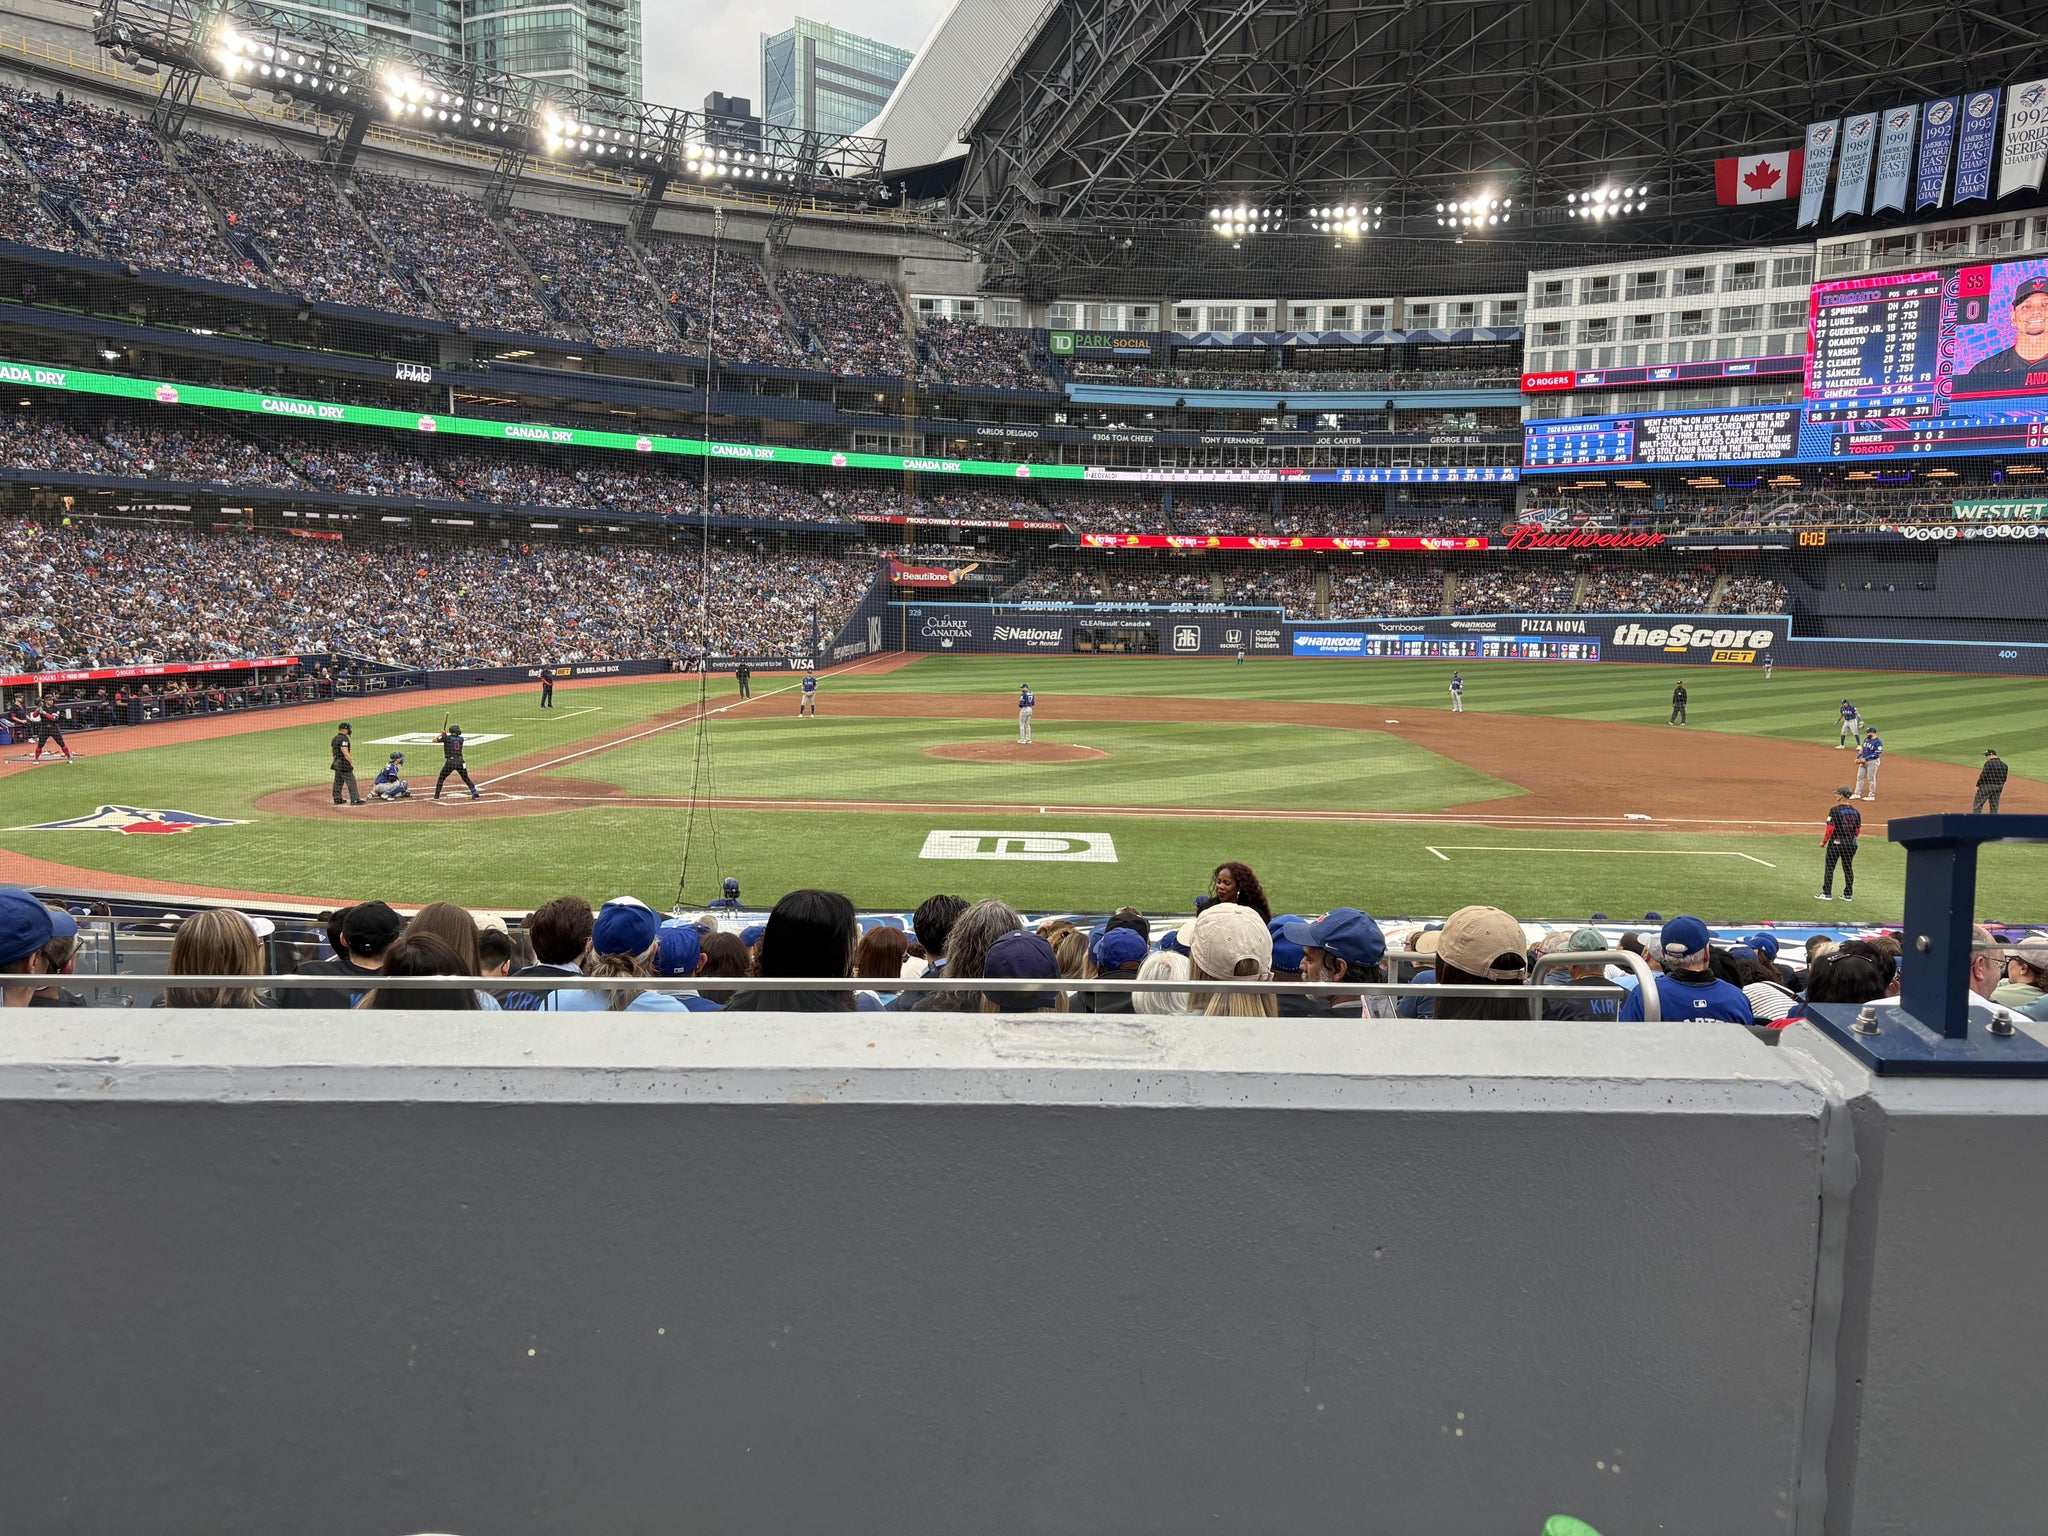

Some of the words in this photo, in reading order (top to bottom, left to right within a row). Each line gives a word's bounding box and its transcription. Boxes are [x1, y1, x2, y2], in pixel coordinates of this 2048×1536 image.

[2011, 107, 2048, 129] 1992
[1886, 133, 1908, 145] 1991
[1927, 126, 1951, 139] 1992
[2008, 127, 2048, 143] WORLD
[1847, 140, 1869, 152] 1989
[1963, 140, 1990, 151] LEAGUE
[2005, 139, 2047, 156] SERIES
[1810, 147, 1832, 159] 1985
[1882, 153, 1908, 163] LEAGUE
[1962, 148, 1988, 161] EAST
[2004, 151, 2046, 165] CHAMPIONS
[1842, 159, 1867, 170] LEAGUE
[1881, 161, 1907, 172] EAST
[1842, 168, 1866, 179] EAST
[1960, 172, 1985, 186] ALCS
[1967, 274, 1983, 288] SS
[1830, 305, 1868, 316] SPRINGER
[1901, 300, 1919, 309] .679
[1830, 317, 1854, 326] LUKES
[1900, 311, 1917, 319] .753
[1829, 326, 1868, 336] GUERRERO
[1870, 324, 1883, 333] JR.
[1900, 321, 1916, 330] .712
[1053, 336, 1072, 349] TD
[1076, 335, 1112, 346] PARK
[1113, 339, 1151, 348] SOCIAL
[1828, 337, 1865, 346] OKAMOTO
[1885, 334, 1895, 342] 3B
[1899, 332, 1916, 340] .790
[1827, 348, 1858, 357] VARSHO
[1885, 344, 1895, 352] CF
[1899, 343, 1914, 351] .781
[1826, 357, 1862, 367] CLEMENT
[1883, 355, 1893, 363] 2B
[1898, 353, 1913, 361] .751
[395, 369, 431, 382] KPMG
[1826, 367, 1860, 377] SÁNCHEZ
[1896, 364, 1914, 372] .757
[1537, 377, 1568, 385] ROGERS
[1825, 378, 1873, 388] VALENZUELA
[1896, 374, 1913, 383] .764
[1824, 388, 1858, 398] GIMÉNEZ
[1895, 385, 1912, 394] .645
[262, 399, 316, 415] CANADA
[1888, 408, 1905, 416] .274
[1729, 414, 1759, 422] AGAINST
[505, 426, 550, 439] CANADA
[1850, 435, 1882, 443] RANGERS
[1640, 440, 1681, 448] MULTI-STEAL
[1849, 445, 1895, 454] TORONTO
[711, 445, 753, 457] CANADA
[903, 459, 940, 470] CANADA
[1502, 524, 1666, 550] Budweiser
[1800, 532, 1826, 546] 0:03
[1905, 527, 1957, 539] VOTE
[1985, 526, 2037, 538] BLUE
[902, 572, 948, 581] BeautiTone
[927, 616, 968, 629] CLEARLY
[1521, 619, 1552, 631] PIZZA
[1556, 620, 1585, 633] NOVA
[921, 626, 972, 638] CANADIAN
[1613, 624, 1773, 648] theScore
[1716, 652, 1751, 661] BET
[788, 659, 815, 669] VISA
[949, 836, 1092, 854] TD
